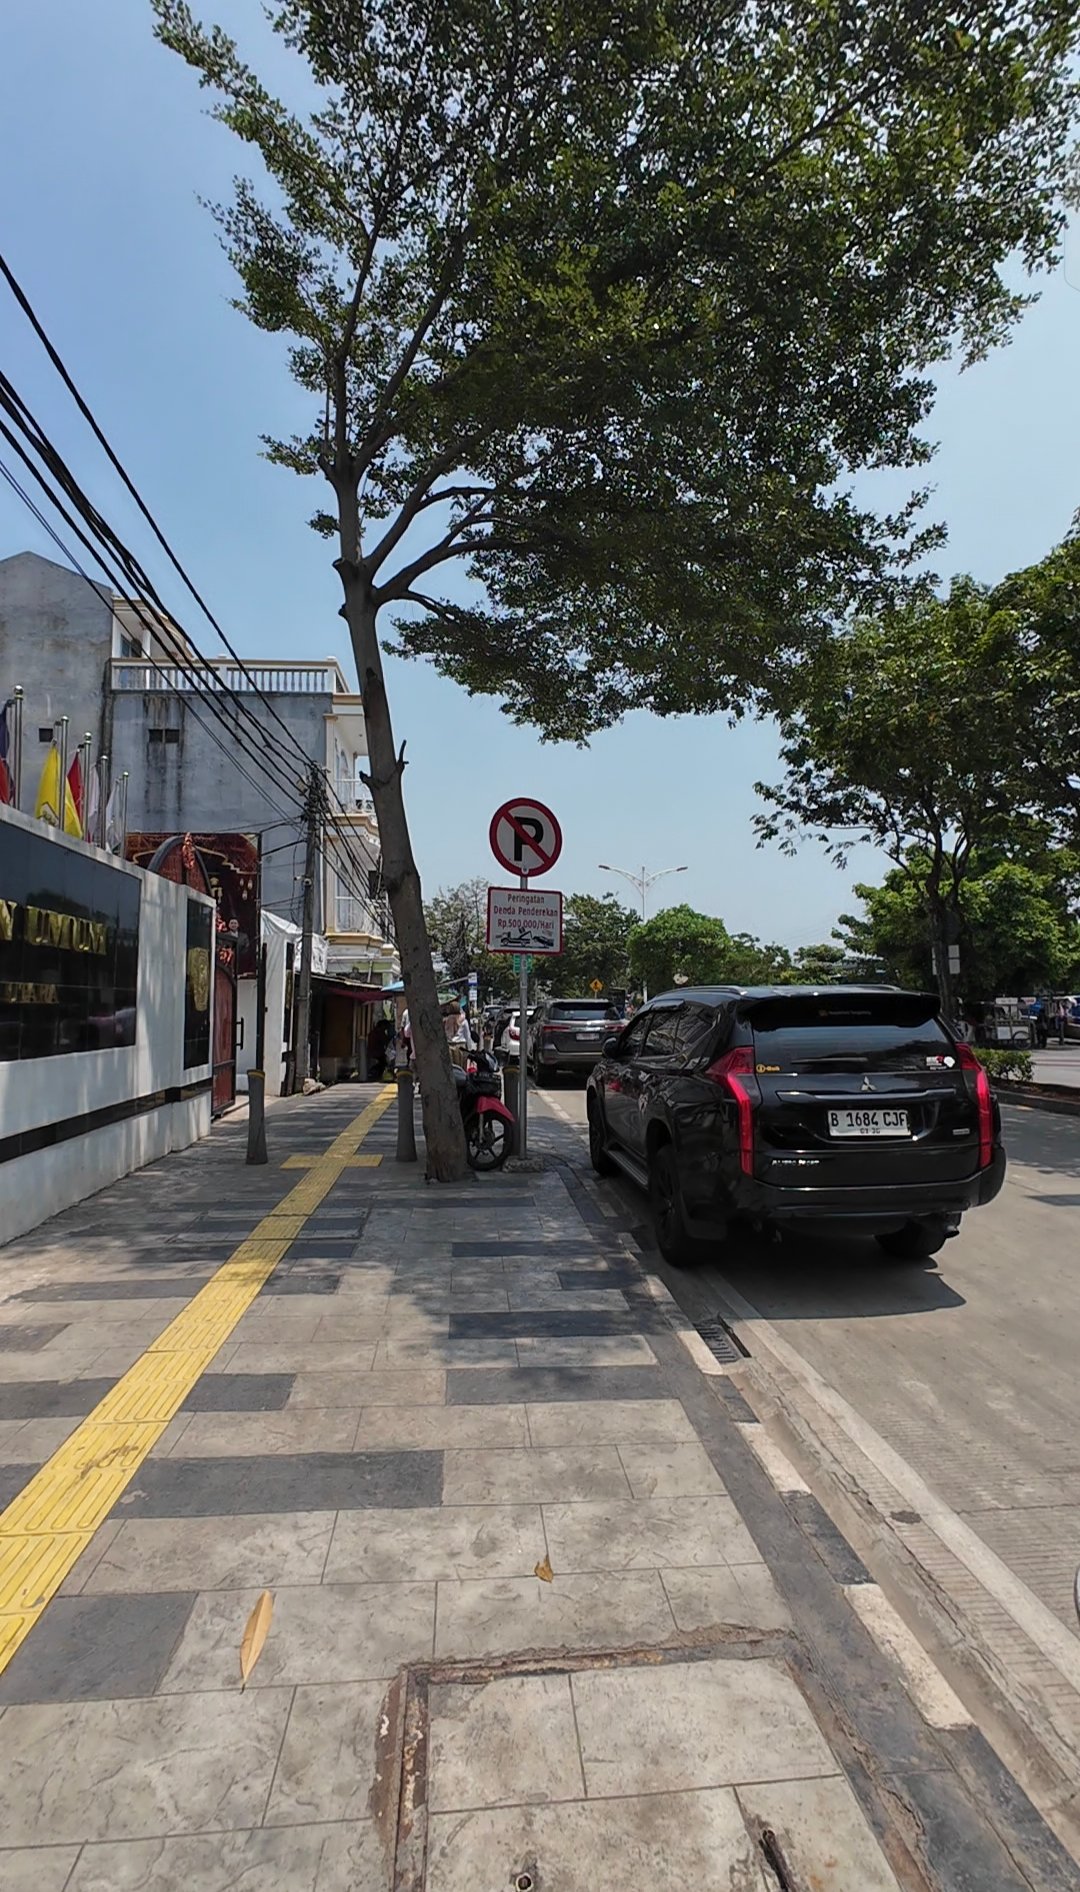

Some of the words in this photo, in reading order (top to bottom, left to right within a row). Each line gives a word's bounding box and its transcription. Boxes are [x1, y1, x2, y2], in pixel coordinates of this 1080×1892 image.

[513, 816, 544, 862] P
[507, 894, 545, 905] Peringatan
[494, 905, 515, 914] Denda
[518, 907, 558, 917] Penderekan
[24, 905, 107, 956] UMUM
[831, 1112, 839, 1127] B
[846, 1112, 878, 1127] 1684
[883, 1112, 907, 1126] CJF
